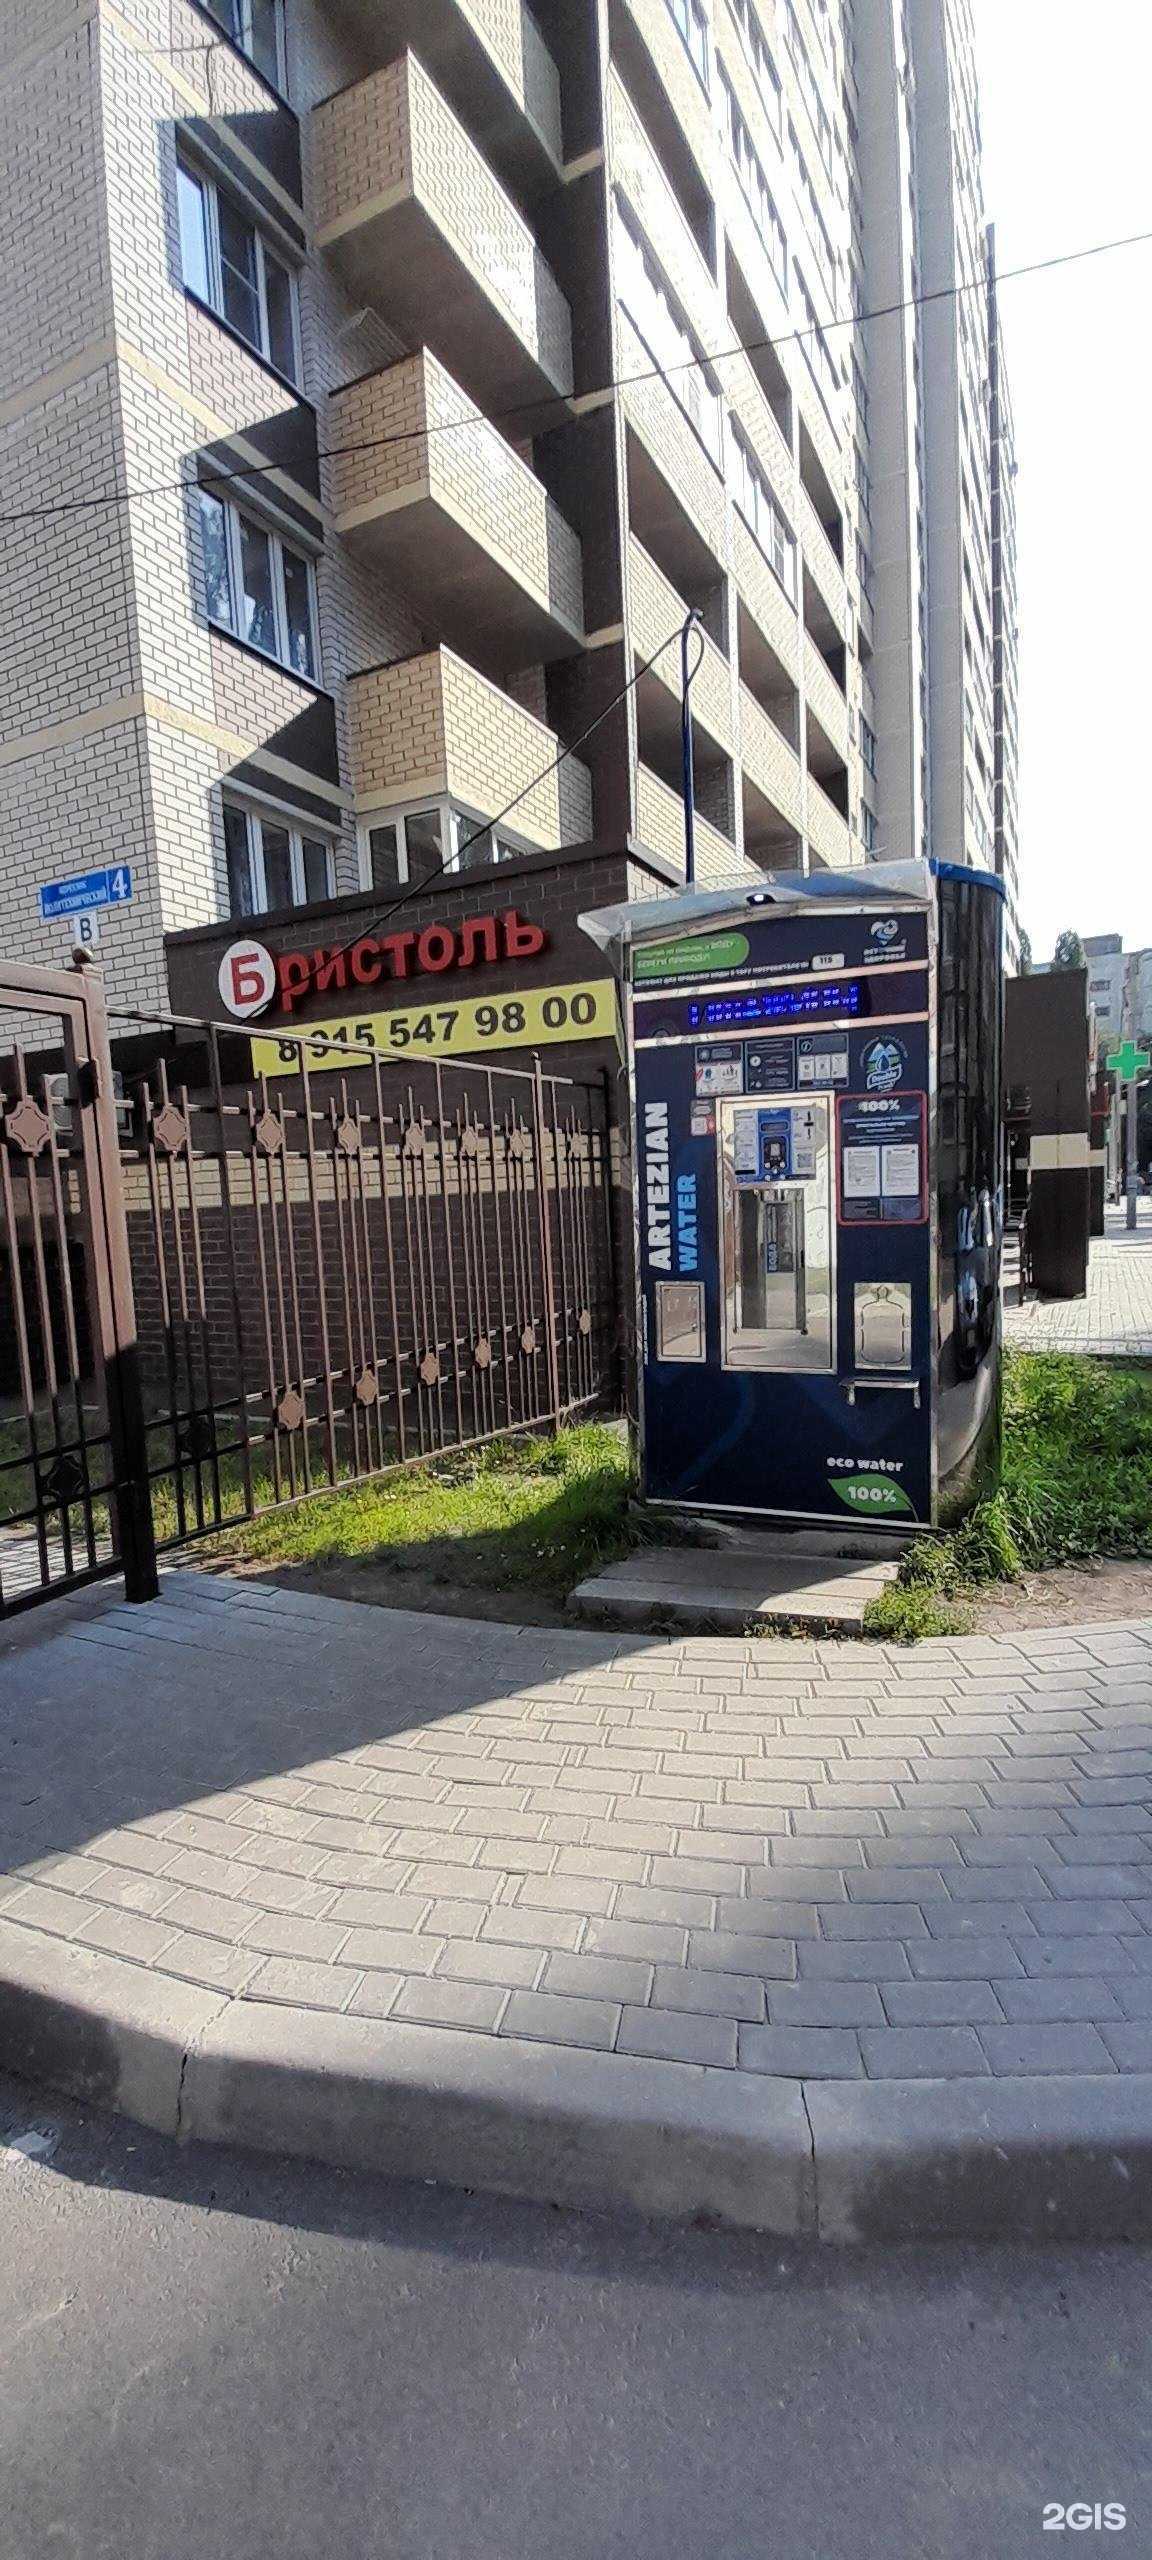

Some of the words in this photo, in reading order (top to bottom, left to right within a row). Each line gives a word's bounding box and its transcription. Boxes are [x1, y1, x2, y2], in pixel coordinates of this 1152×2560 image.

[111, 868, 128, 899] 4
[279, 1039, 297, 1062] 8
[310, 1022, 375, 1059] 915
[389, 1013, 459, 1047] 547
[474, 1001, 526, 1036] 98
[542, 992, 597, 1028] 00
[644, 1102, 671, 1271] ARTEZIAN
[677, 1173, 698, 1272] WATER
[826, 1457, 854, 1468] eco
[857, 1458, 904, 1472] water
[848, 1486, 897, 1503] 100%
